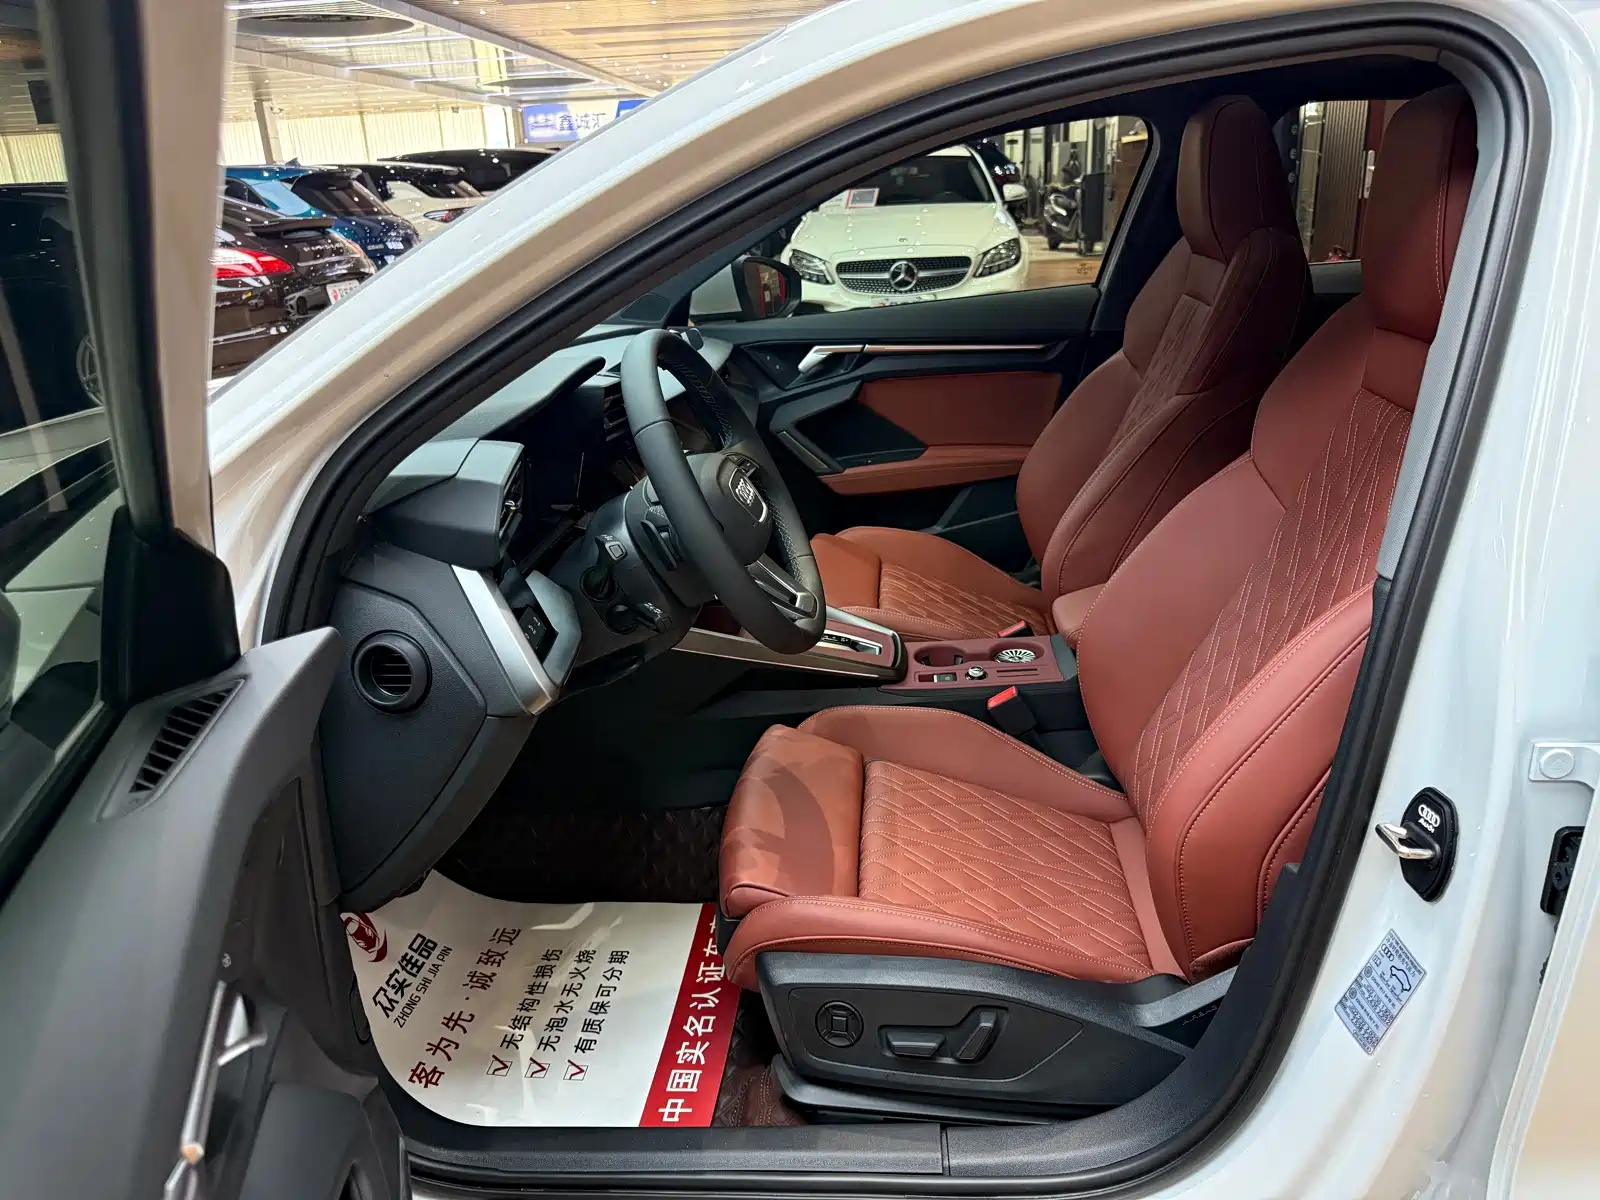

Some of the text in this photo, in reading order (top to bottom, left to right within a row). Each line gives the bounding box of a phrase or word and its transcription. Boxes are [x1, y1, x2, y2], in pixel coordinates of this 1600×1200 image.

[1418, 818, 1435, 833] Audi
[372, 933, 438, 1018] 众实佳品
[393, 946, 452, 1028] ZHONG SHI JIA PIN
[500, 949, 562, 1050] 无结构性损伤
[537, 949, 596, 1052] 无泡水无火烧
[574, 950, 630, 1054] 有质保可分期
